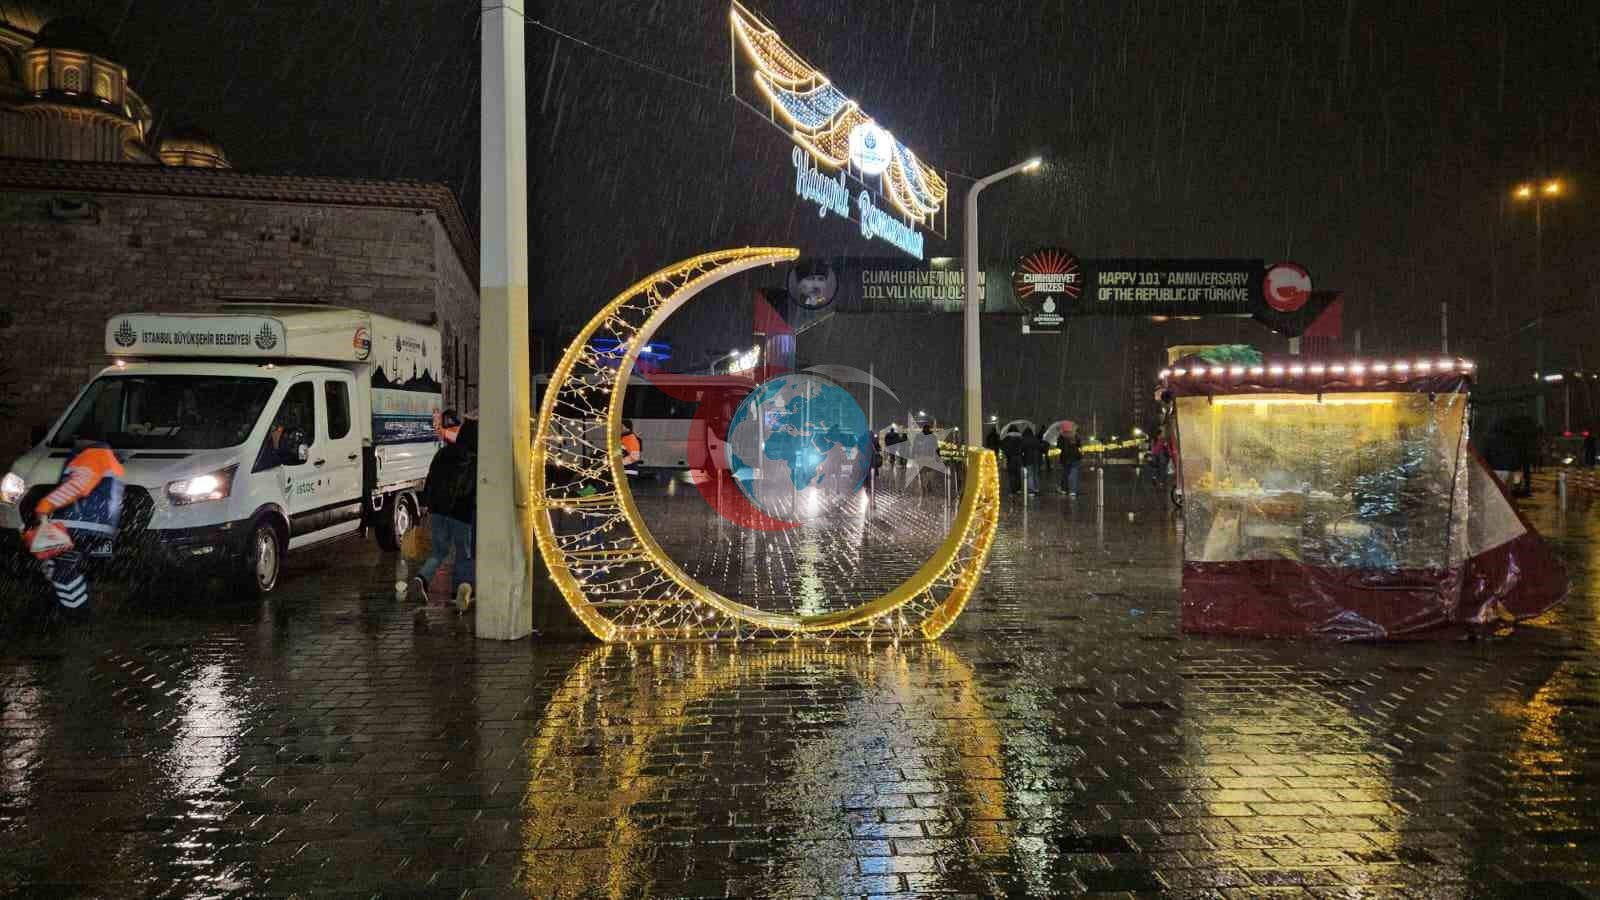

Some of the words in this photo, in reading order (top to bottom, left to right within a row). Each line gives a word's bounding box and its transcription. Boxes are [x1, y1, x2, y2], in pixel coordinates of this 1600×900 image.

[1098, 271, 1136, 285] HAPPY
[1168, 271, 1249, 285] ANNIVERSARY
[910, 286, 945, 299] KUTLU
[947, 286, 985, 299] OLSN
[1098, 287, 1112, 301] OF
[1113, 287, 1134, 301] THE
[1135, 287, 1186, 301] REPUBLIC
[1187, 287, 1201, 301] OF
